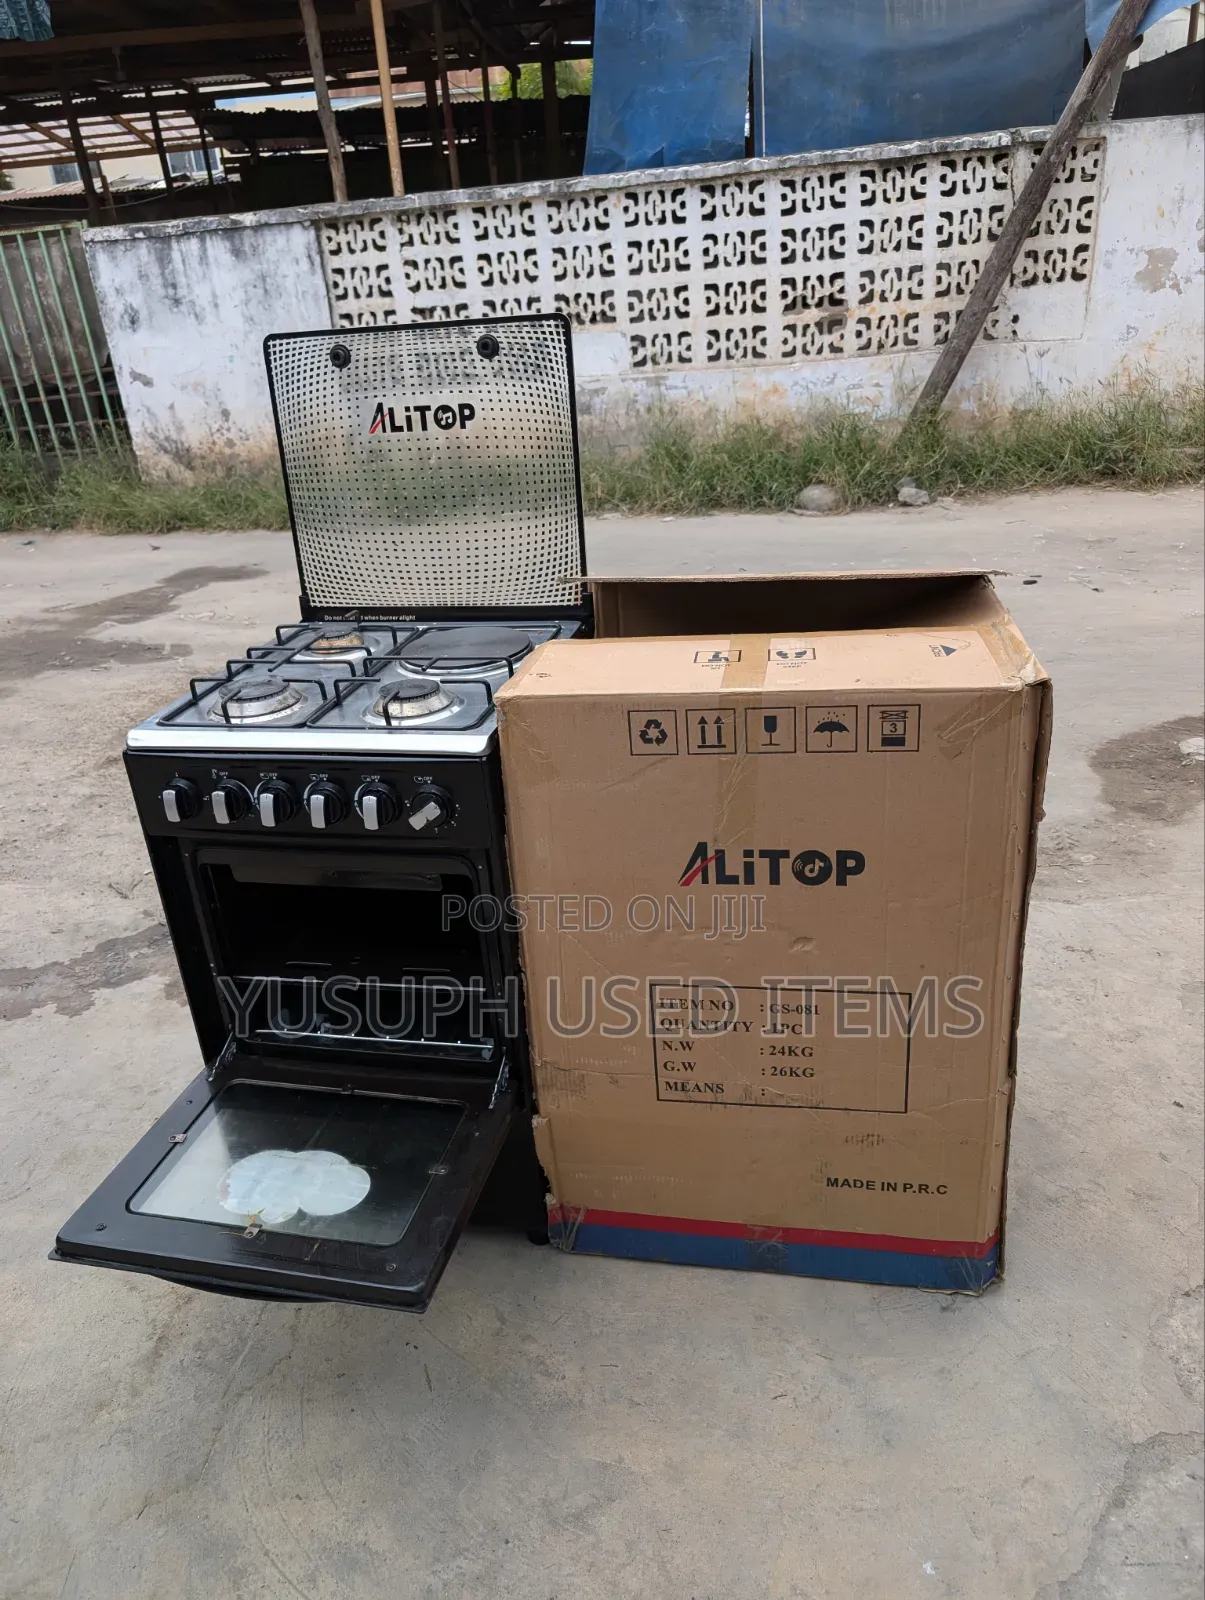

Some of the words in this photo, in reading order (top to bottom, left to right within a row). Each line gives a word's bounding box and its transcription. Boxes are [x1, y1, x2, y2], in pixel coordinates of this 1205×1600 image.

[398, 614, 416, 622] alight
[889, 722, 898, 733] 3
[658, 998, 705, 1011] ITEM
[709, 1000, 734, 1011] NO
[769, 1003, 821, 1015] GS-081
[660, 1018, 754, 1033] QUANTITY
[771, 1022, 803, 1035] 1PC
[662, 1040, 695, 1052] N.W
[769, 1045, 814, 1058] 24KG
[663, 1060, 697, 1072] G.W
[770, 1066, 815, 1078] 26KG
[665, 1081, 725, 1094] MEANS
[826, 1177, 876, 1191] MADE
[881, 1181, 898, 1192] IN
[903, 1182, 948, 1195] P.R.C
